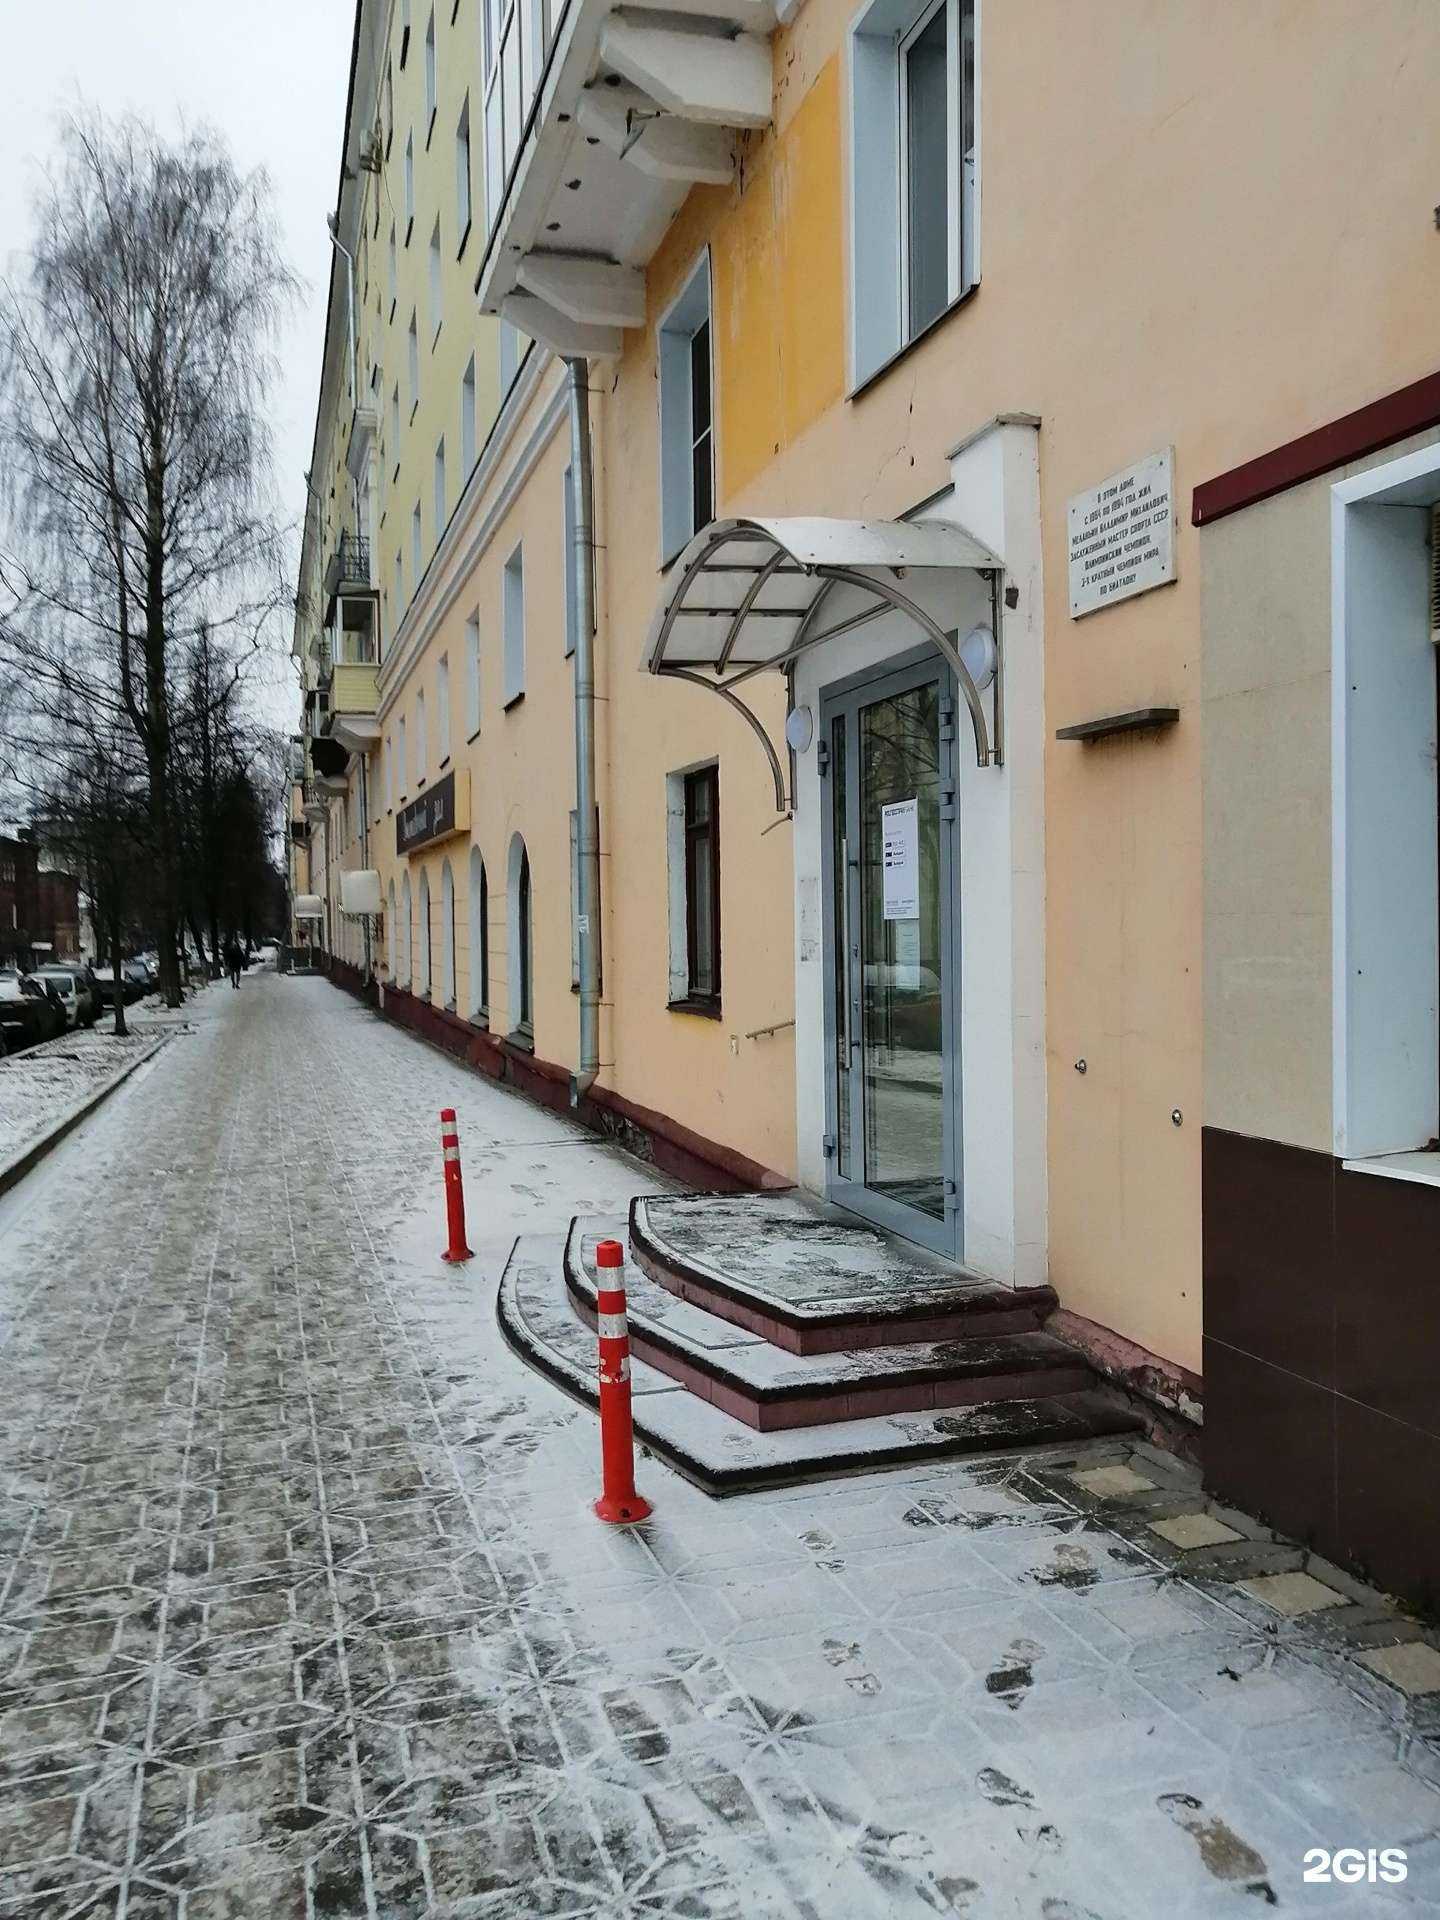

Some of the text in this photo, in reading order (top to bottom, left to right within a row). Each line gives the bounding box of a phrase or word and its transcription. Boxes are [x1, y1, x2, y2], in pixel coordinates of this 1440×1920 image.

[1139, 484, 1152, 498] ЖИЛ
[1107, 528, 1128, 545] МАСТЕР
[1130, 518, 1152, 535] СПОРТА
[1153, 508, 1168, 524] СССР
[1143, 547, 1159, 561] МИРА
